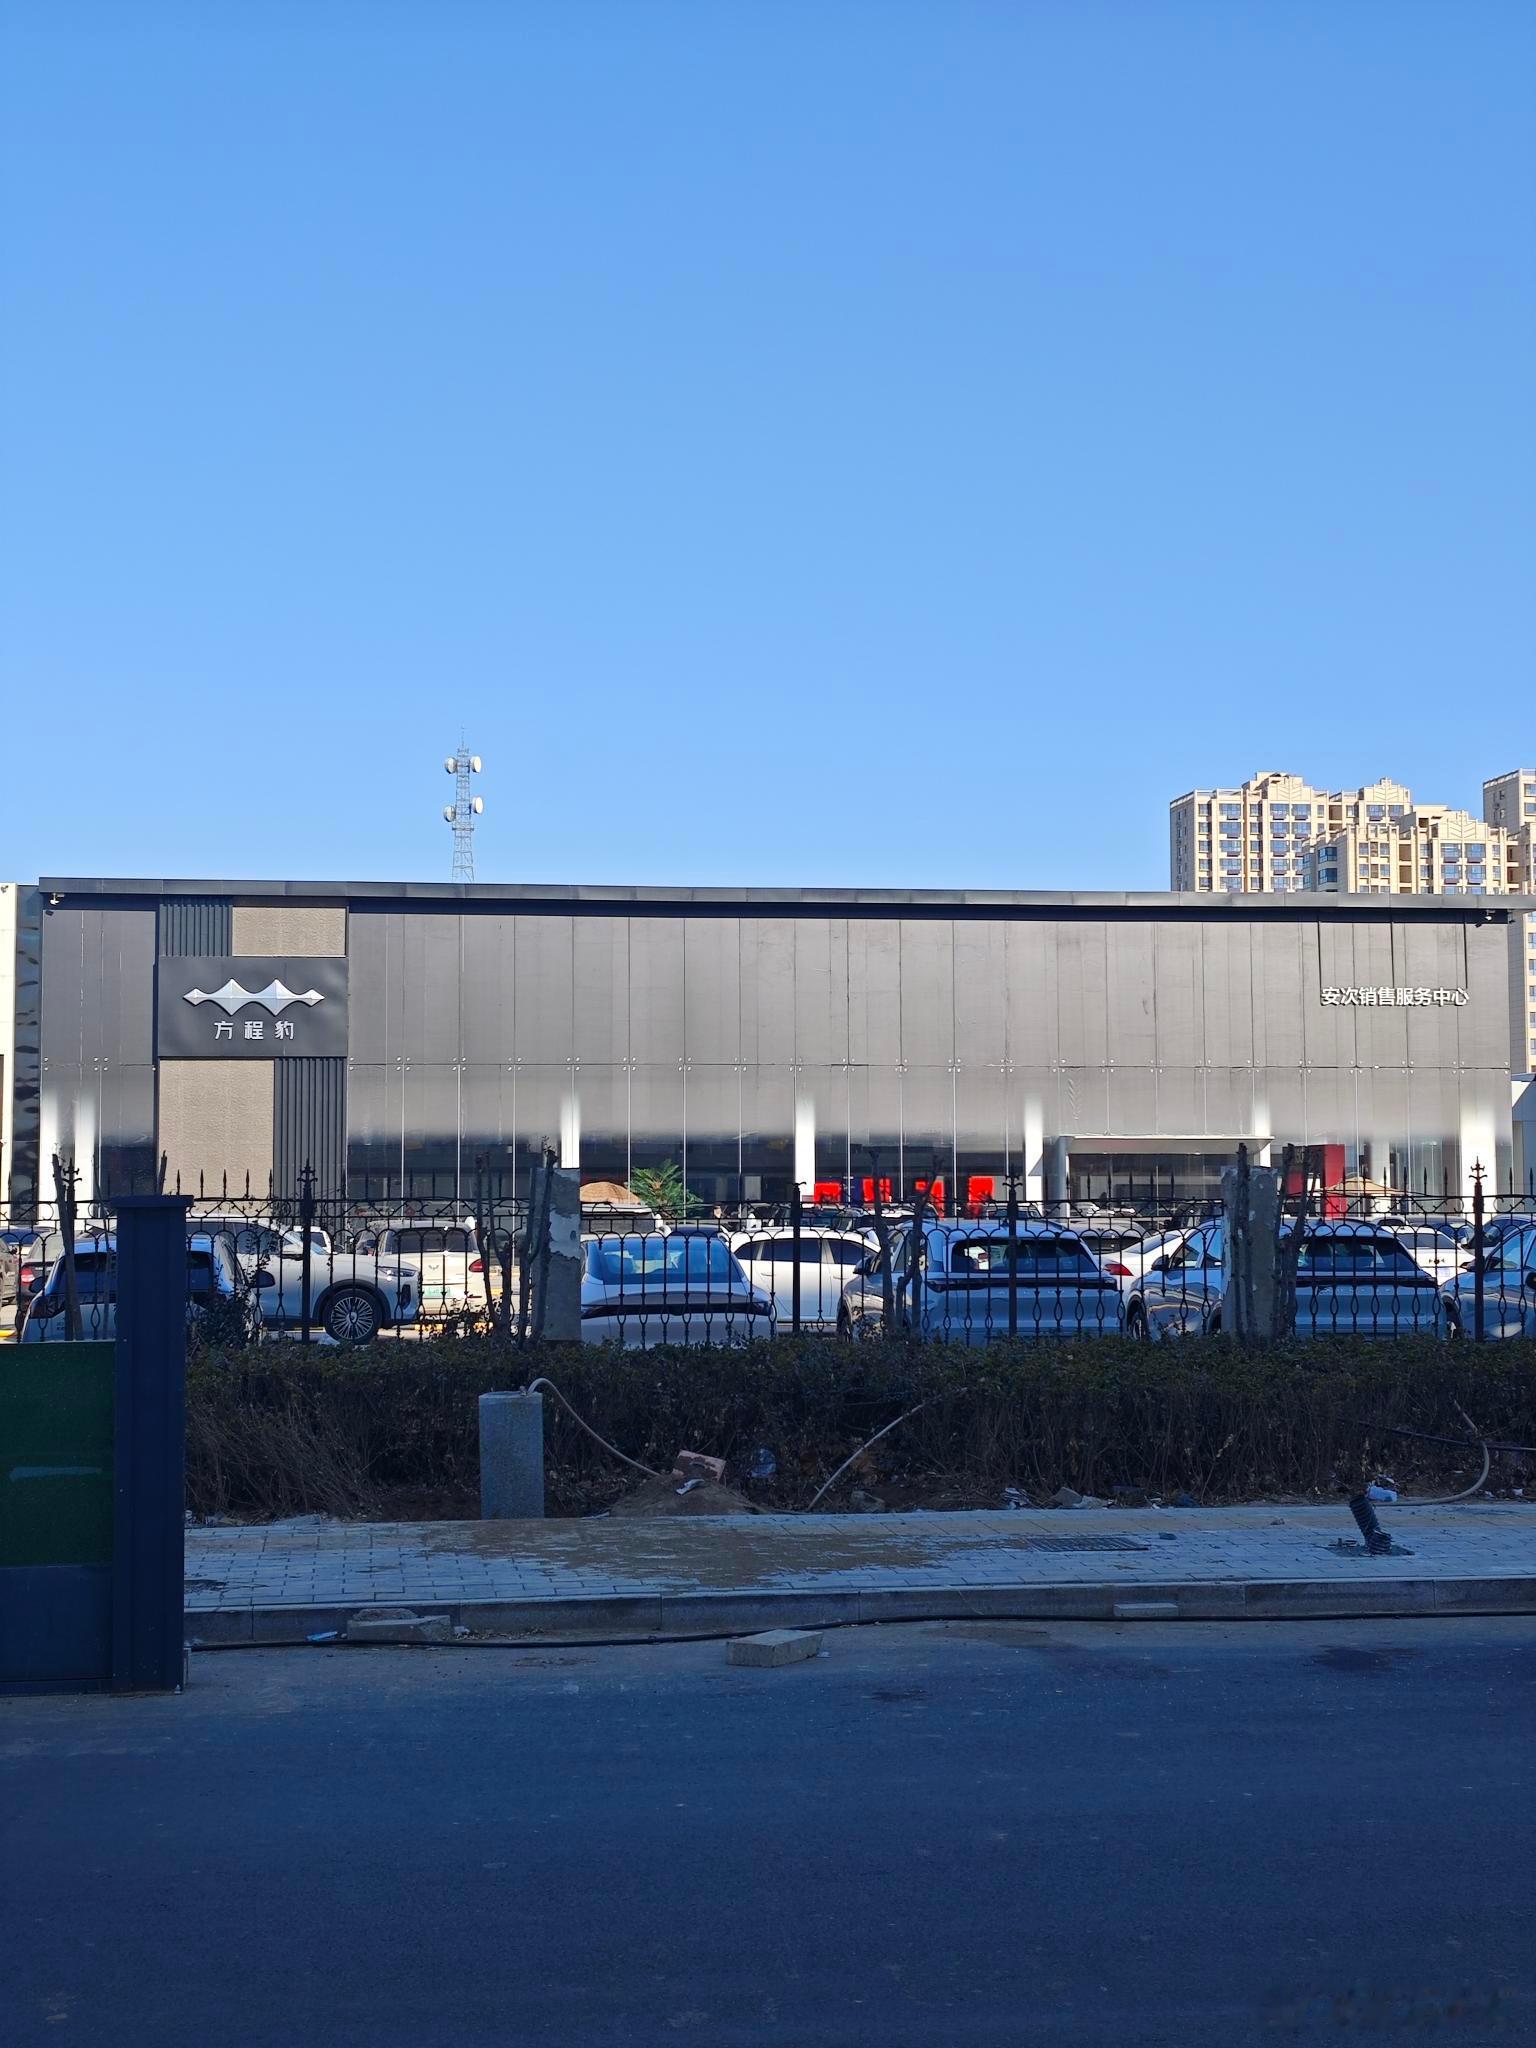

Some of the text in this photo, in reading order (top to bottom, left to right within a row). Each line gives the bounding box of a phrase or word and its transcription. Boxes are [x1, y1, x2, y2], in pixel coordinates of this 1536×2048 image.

[1321, 987, 1470, 1006] 安次销售服务中心
[213, 1020, 295, 1040] 方程豹
